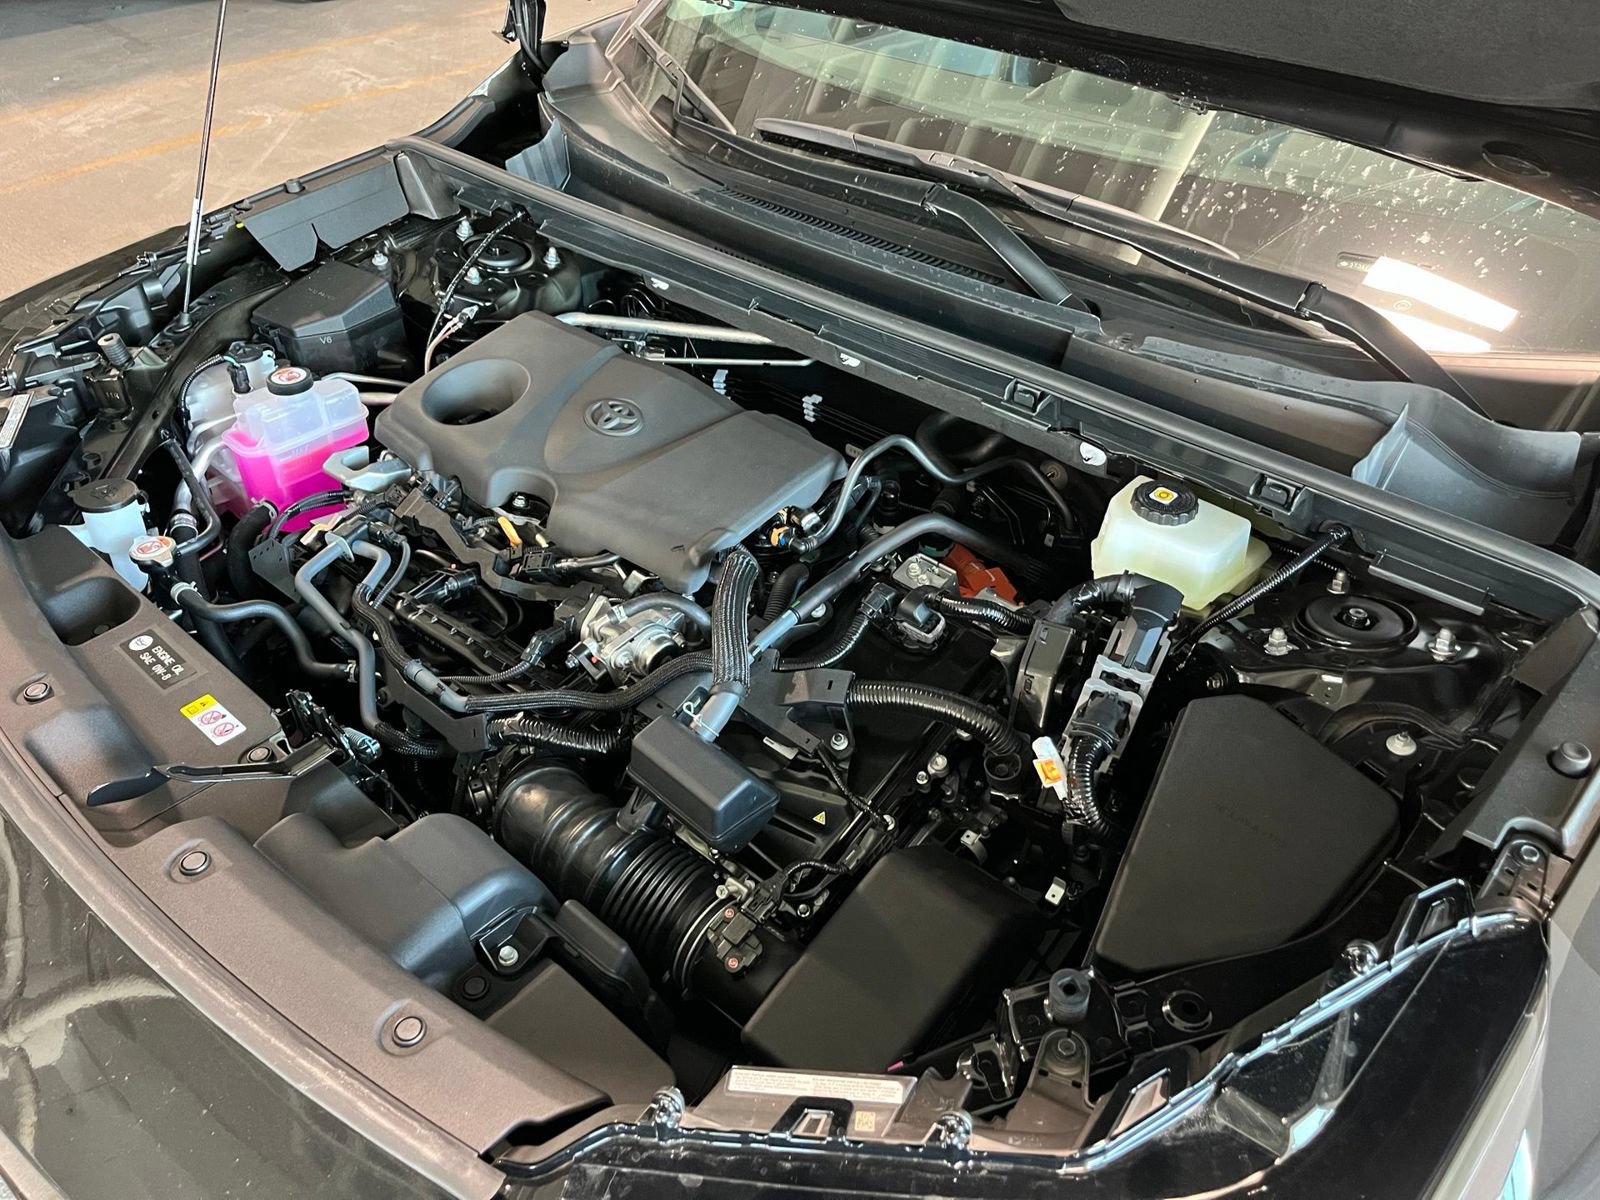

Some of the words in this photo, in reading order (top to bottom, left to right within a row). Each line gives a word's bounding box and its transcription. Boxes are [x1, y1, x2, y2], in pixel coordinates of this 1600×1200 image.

[139, 652, 156, 665] SAE
[151, 664, 172, 681] 0W-8
[151, 645, 176, 666] ENGINE
[172, 664, 185, 676] OIL
